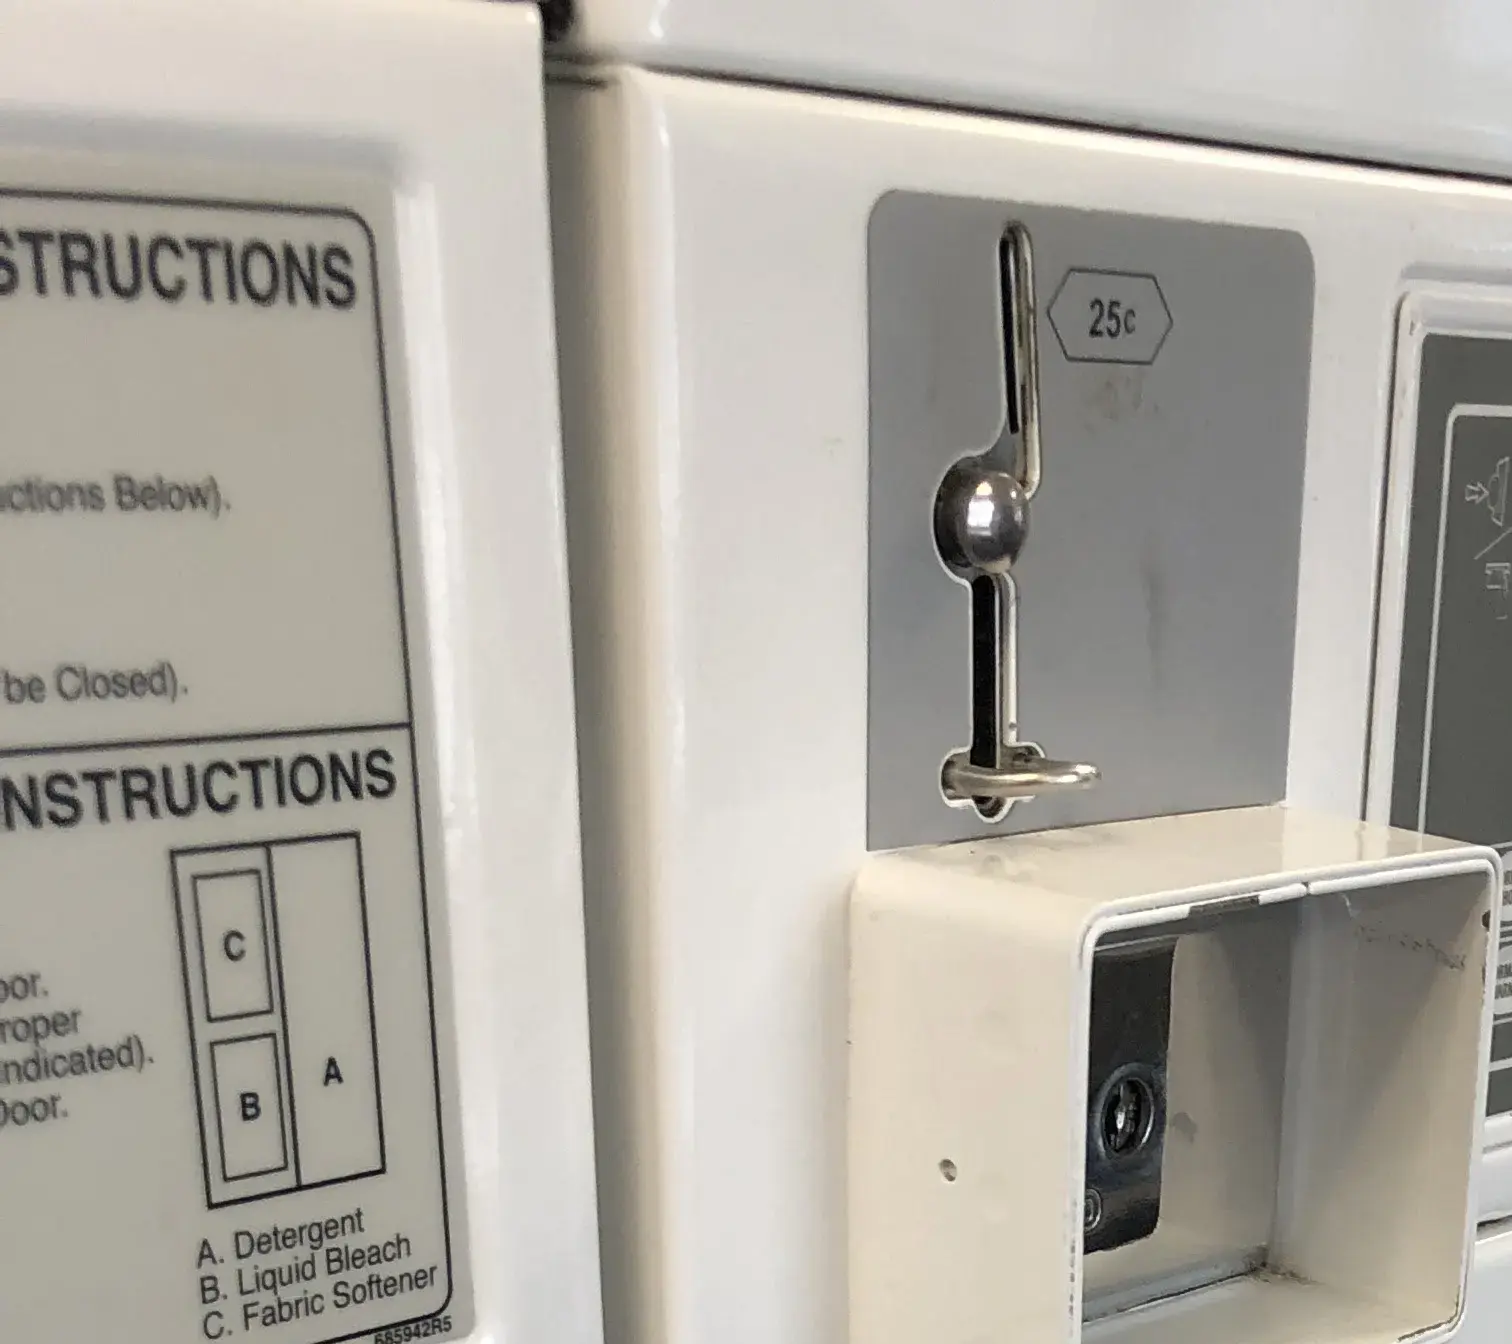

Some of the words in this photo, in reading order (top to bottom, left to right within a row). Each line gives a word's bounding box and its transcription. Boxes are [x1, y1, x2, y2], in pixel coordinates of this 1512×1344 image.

[112, 472, 232, 520] Below).
[3, 666, 47, 703] be
[54, 658, 189, 704] Closed).
[1, 747, 397, 832] NSTRUCTIONS
[222, 928, 247, 962] C
[322, 1056, 344, 1087] A
[239, 1090, 262, 1122] B
[196, 1236, 225, 1270] A.
[233, 1206, 366, 1261] Detergent
[199, 1274, 229, 1306] B.
[236, 1251, 317, 1297] Liquid
[324, 1232, 413, 1276] Bleach
[202, 1309, 234, 1341] C.
[242, 1288, 325, 1333] Fabric
[332, 1264, 439, 1310] Softener
